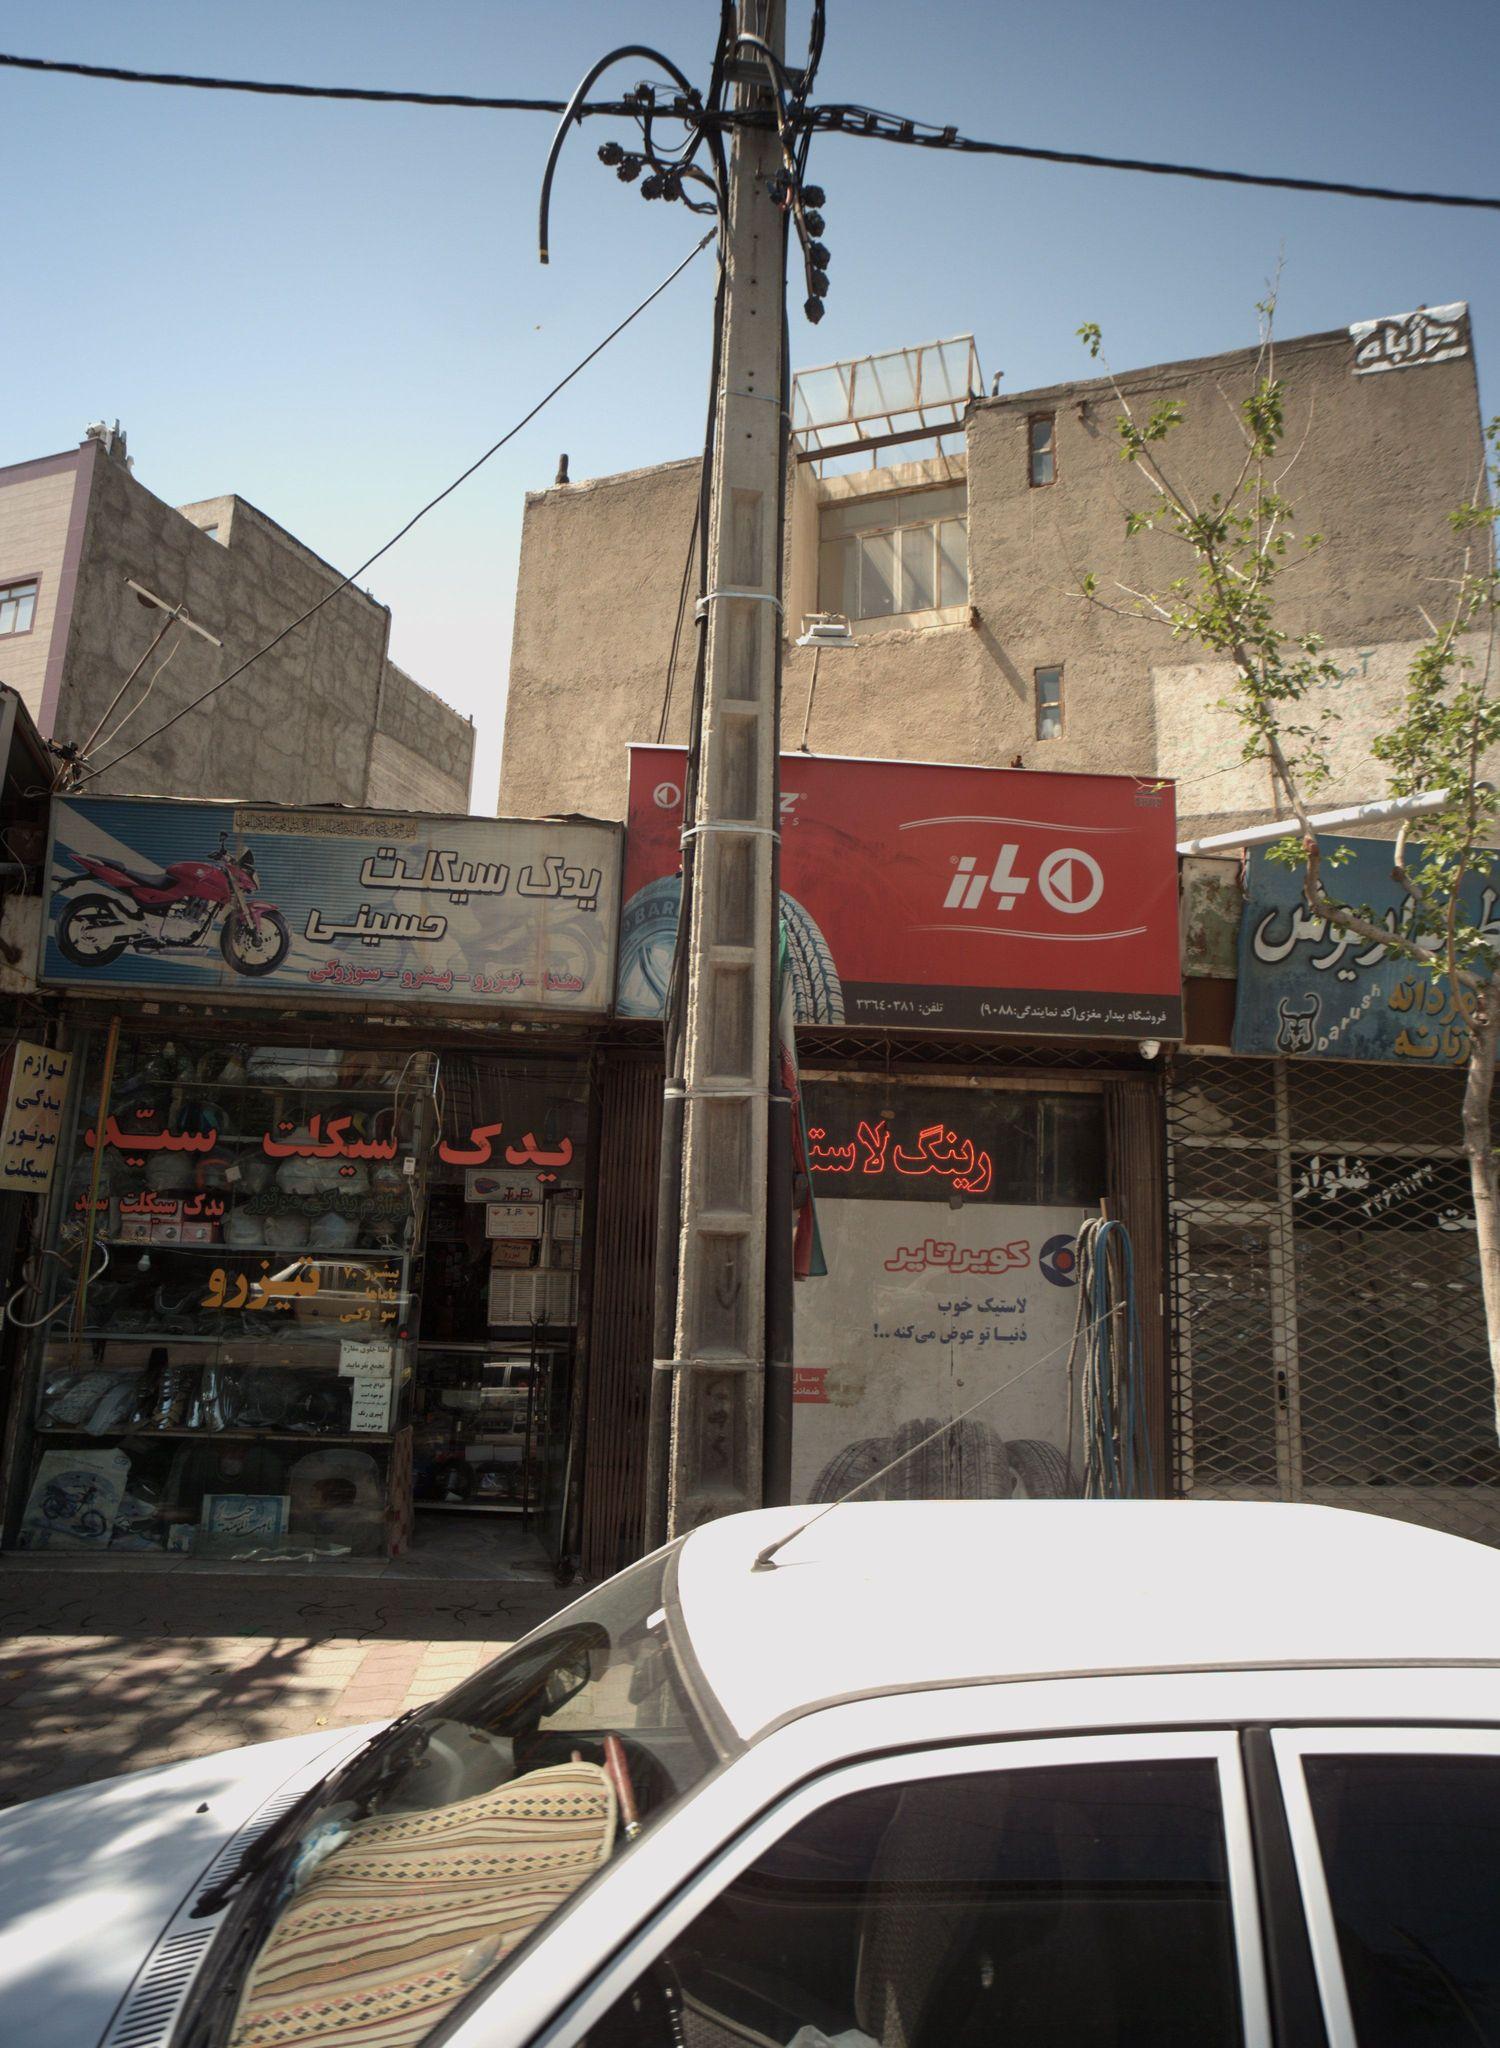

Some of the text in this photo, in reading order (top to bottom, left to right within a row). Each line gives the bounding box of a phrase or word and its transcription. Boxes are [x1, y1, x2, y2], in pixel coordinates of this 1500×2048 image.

[359, 846, 603, 912] یدک سیکلت
[943, 843, 1030, 911] بارز
[304, 903, 448, 947] حسینی
[308, 958, 584, 993] هندا تیزرو پیشرو سوزوکی
[1104, 1009, 1125, 1023] بیدار
[1127, 1009, 1167, 1025] فروشگاه
[1318, 983, 1382, 1051] Darush
[23, 1054, 67, 1080] لوازم
[15, 1089, 61, 1116] یدکی
[7, 1123, 56, 1150] موتور
[262, 1113, 398, 1177] سیکلت
[438, 1122, 574, 1184] یدک
[4, 1157, 48, 1184] سیکلت
[808, 1120, 992, 1193] رینگ لاست
[1292, 1155, 1371, 1201] شلوار
[118, 1190, 178, 1225] سیکلت
[182, 1192, 225, 1228] یدک
[200, 1255, 320, 1310] تیزرو
[937, 1295, 1028, 1318] لاستیک خوب
[939, 1325, 975, 1345] عوض
